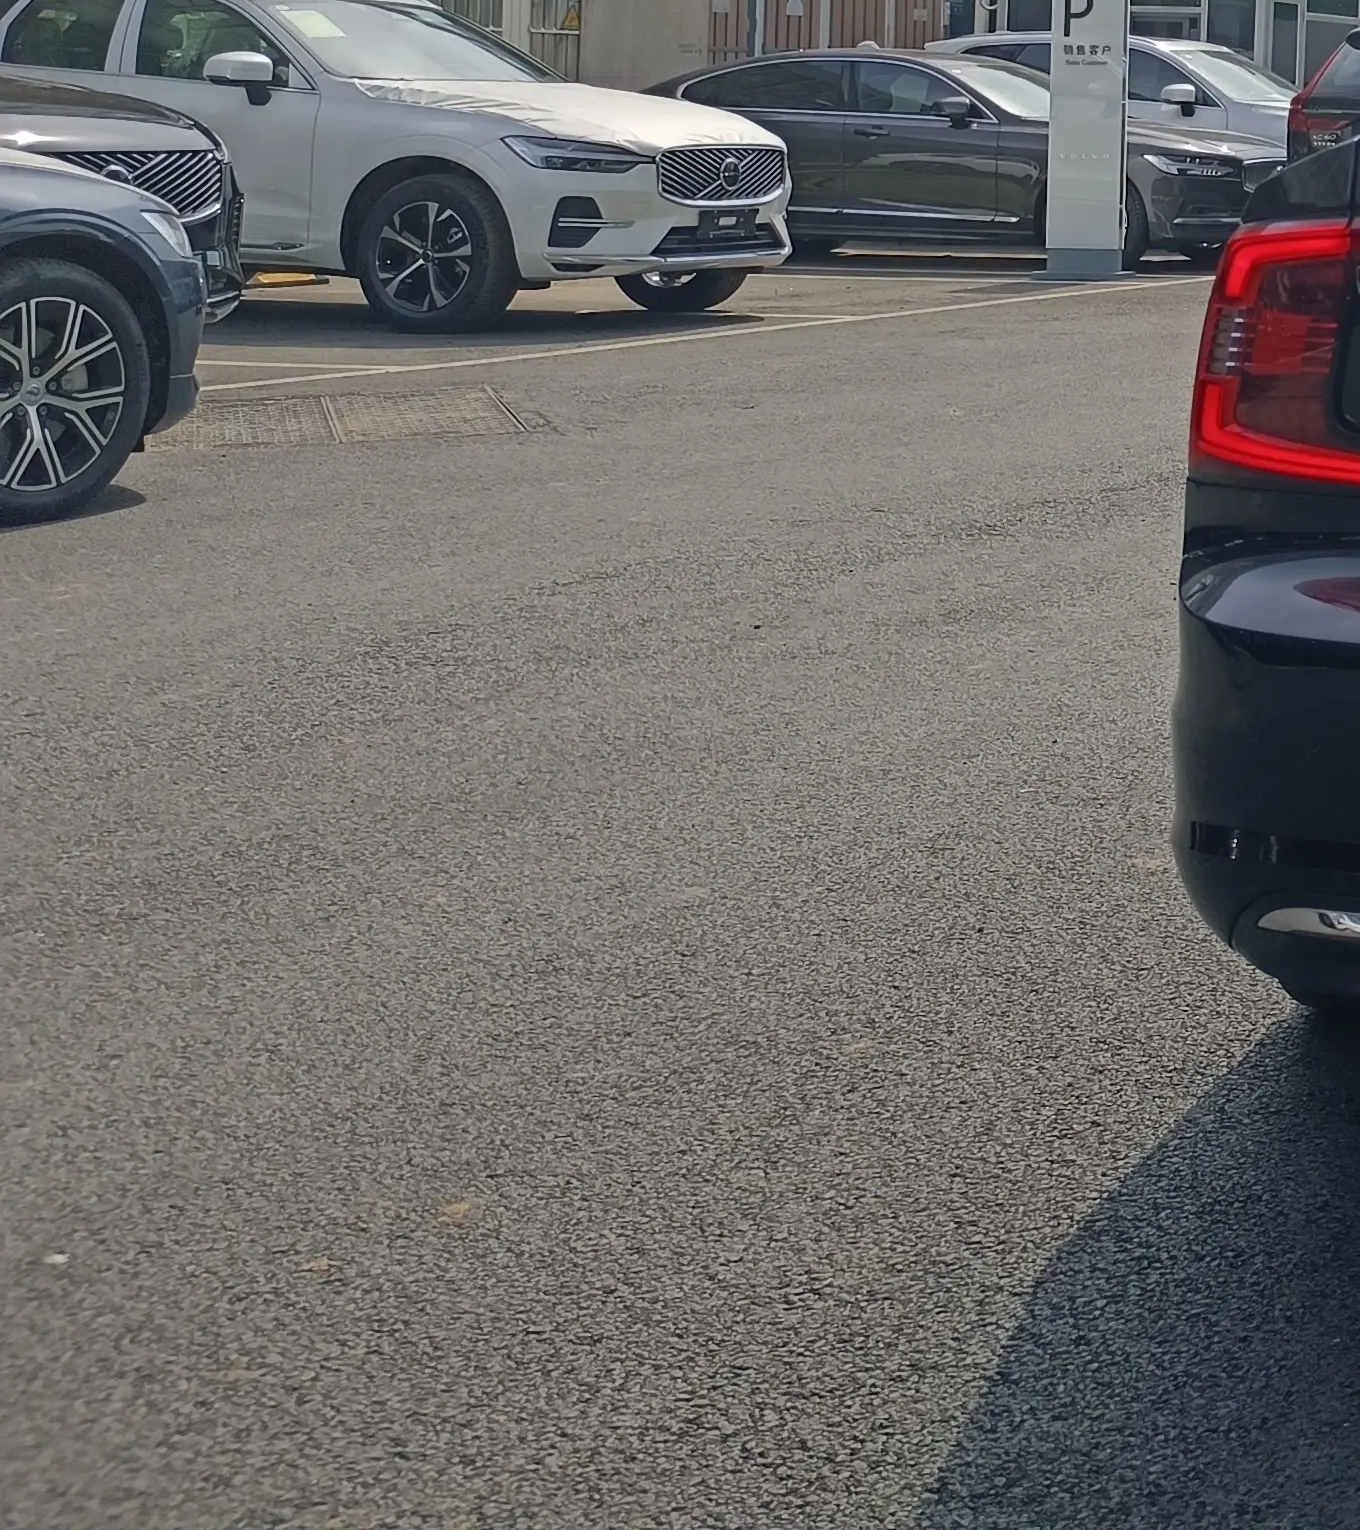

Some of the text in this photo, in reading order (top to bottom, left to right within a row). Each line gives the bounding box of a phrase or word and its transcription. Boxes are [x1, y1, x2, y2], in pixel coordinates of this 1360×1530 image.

[1063, 44, 1112, 56] 销售客户
[1059, 152, 1112, 160] VOLVO
